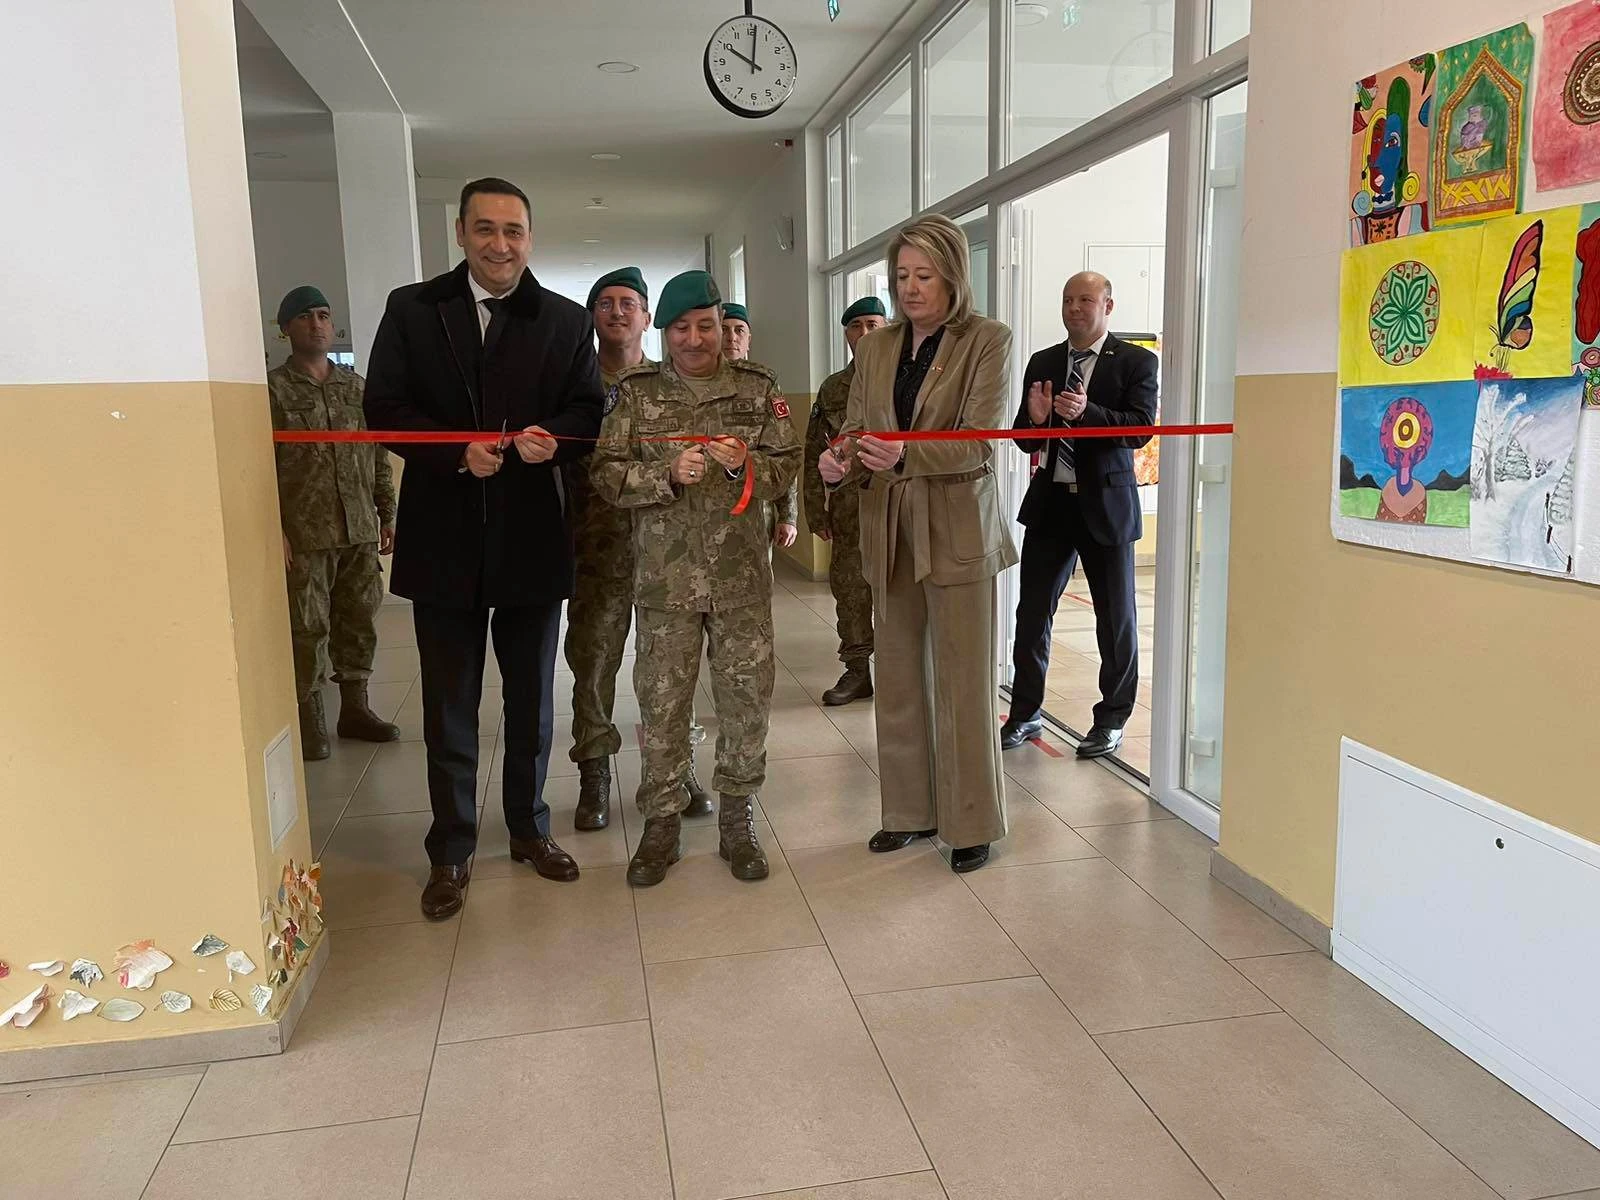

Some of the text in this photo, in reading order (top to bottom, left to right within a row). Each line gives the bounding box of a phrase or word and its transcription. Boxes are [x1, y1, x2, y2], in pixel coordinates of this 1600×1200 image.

[734, 32, 740, 40] 11
[747, 28, 756, 36] 12
[774, 46, 781, 55] 2
[719, 58, 726, 66] 9
[779, 63, 786, 71] 3
[724, 74, 731, 82] 8
[775, 78, 782, 86] 4
[737, 87, 743, 95] 7
[765, 89, 772, 97] 5
[750, 93, 757, 101] 6
